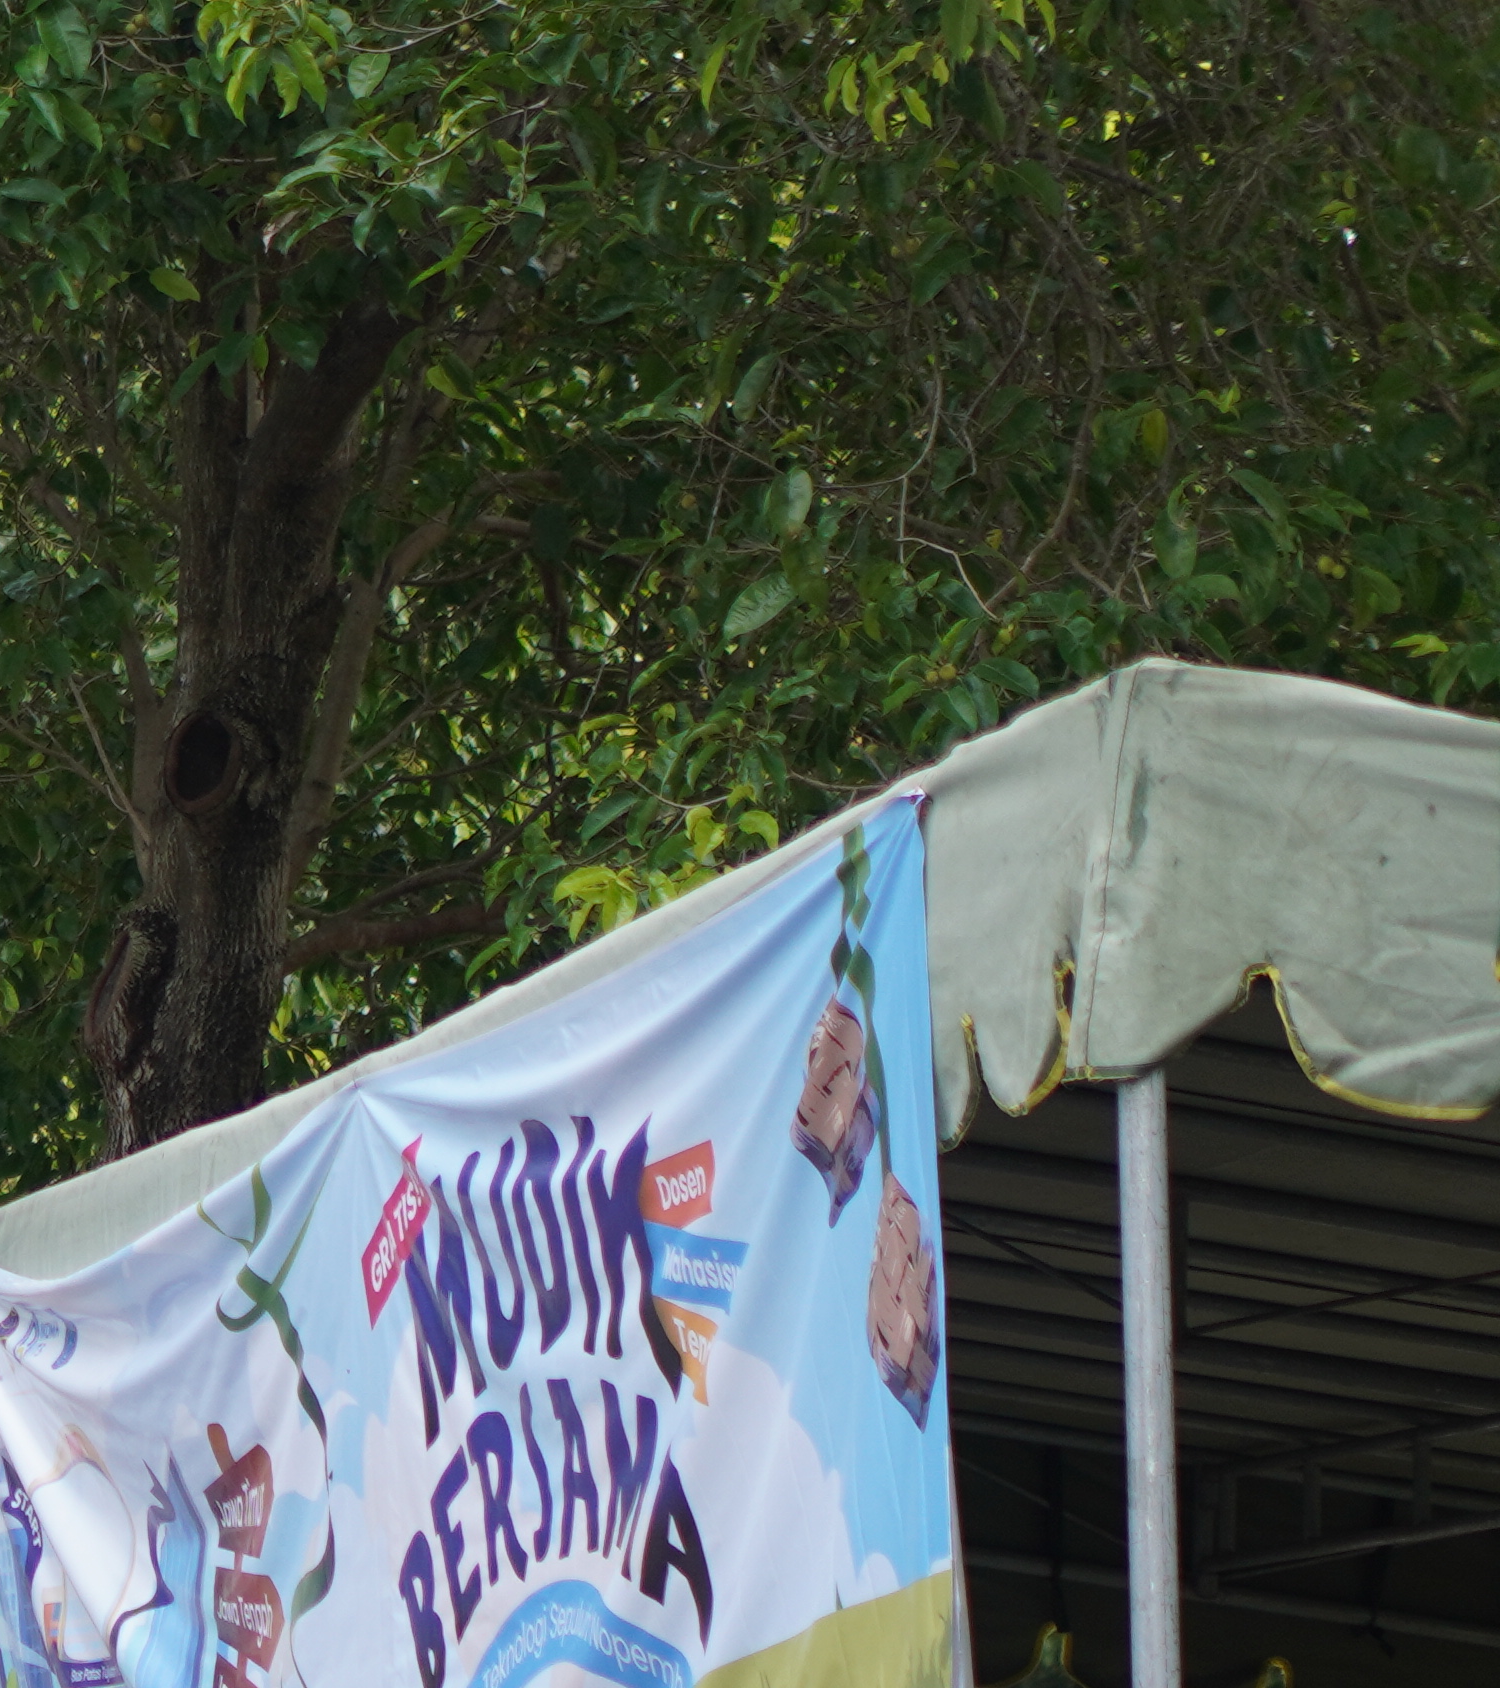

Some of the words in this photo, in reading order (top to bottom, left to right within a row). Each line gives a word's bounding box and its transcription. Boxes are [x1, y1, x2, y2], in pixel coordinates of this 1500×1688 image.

[655, 1165, 706, 1212] Dosen
[406, 1113, 682, 1451] MUDIK
[672, 1316, 712, 1366] Ten
[10, 1488, 42, 1549] START
[215, 1499, 243, 1528] Jawa
[400, 1378, 714, 1655] BERSAMA
[216, 1595, 239, 1627] Jawa
[238, 1592, 274, 1648] Tengah
